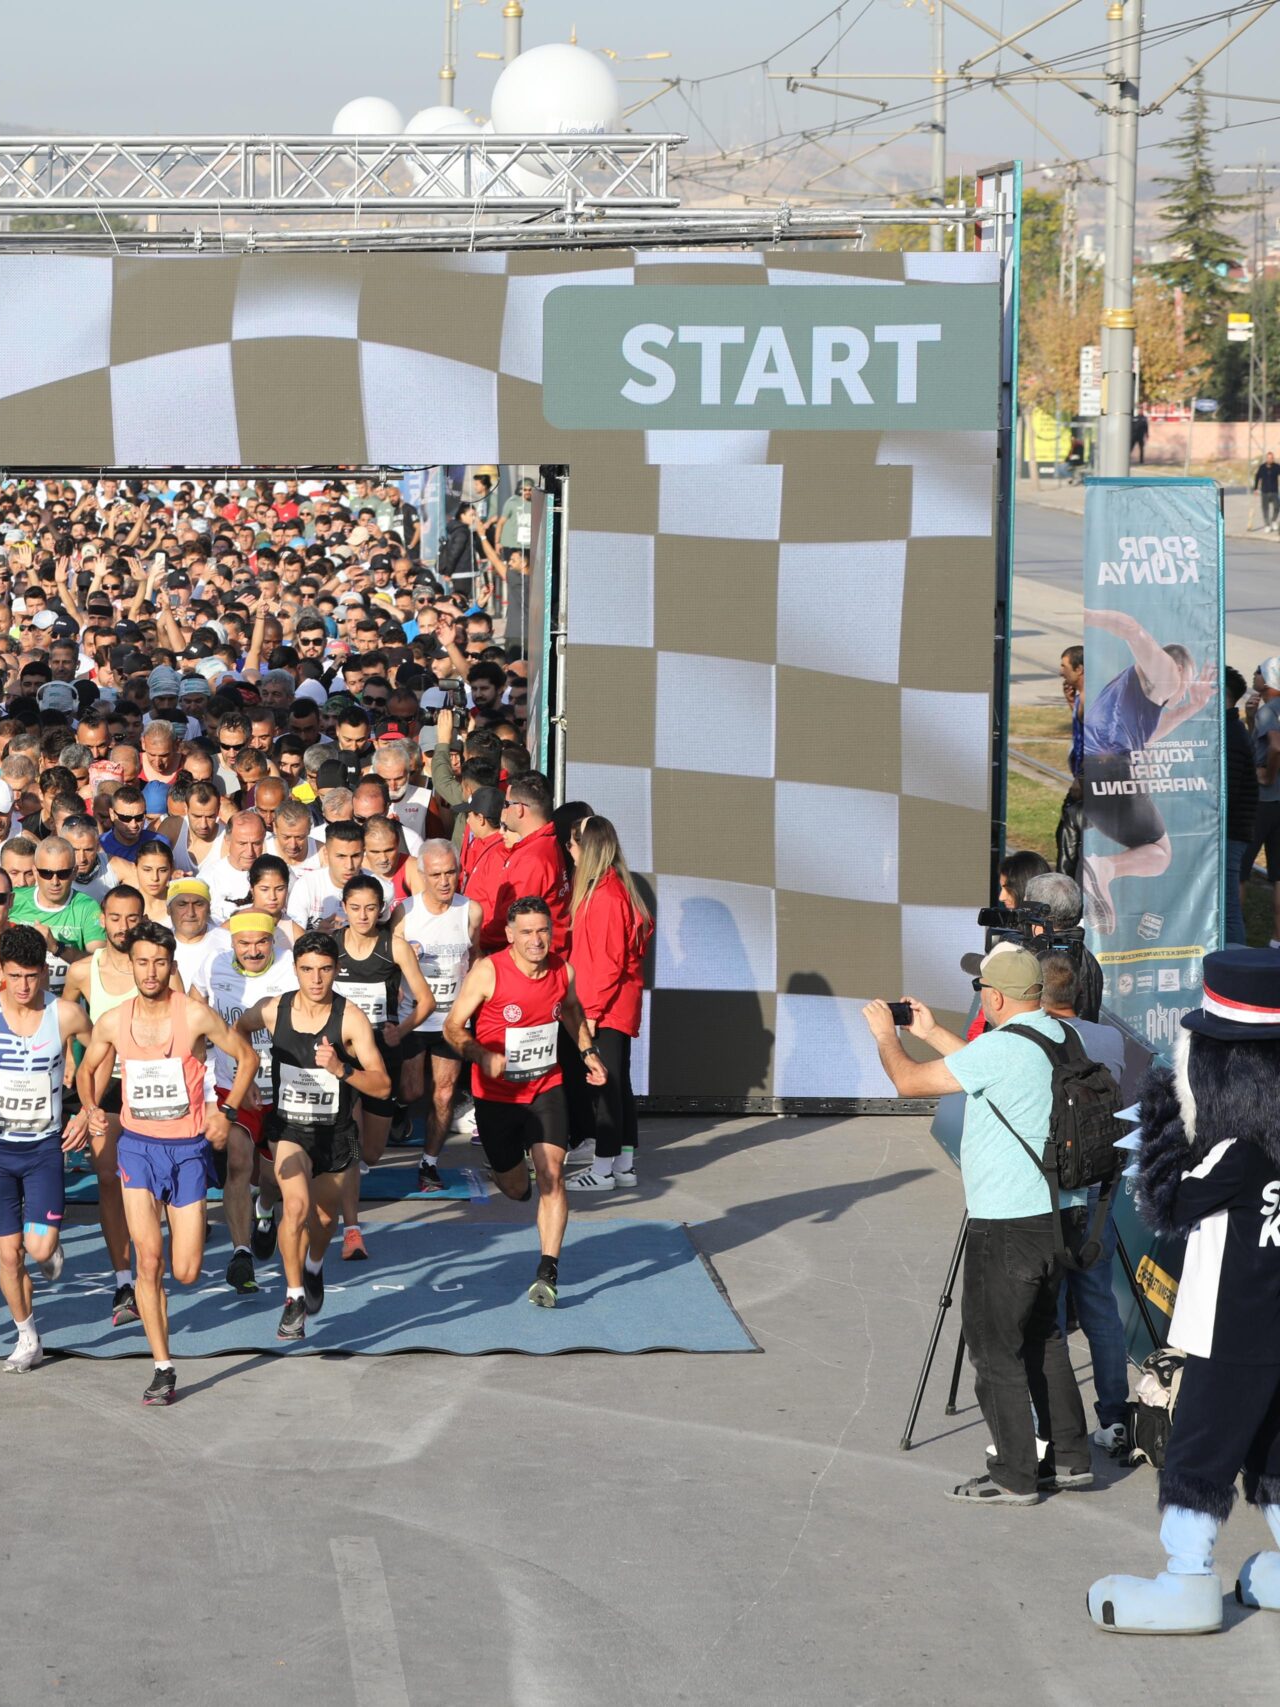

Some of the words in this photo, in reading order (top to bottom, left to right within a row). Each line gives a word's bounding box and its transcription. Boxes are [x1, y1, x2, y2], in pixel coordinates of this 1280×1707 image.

[620, 323, 942, 405] START
[508, 1044, 554, 1063] 3244
[133, 1084, 178, 1099] 2192
[282, 1089, 335, 1105] 2330
